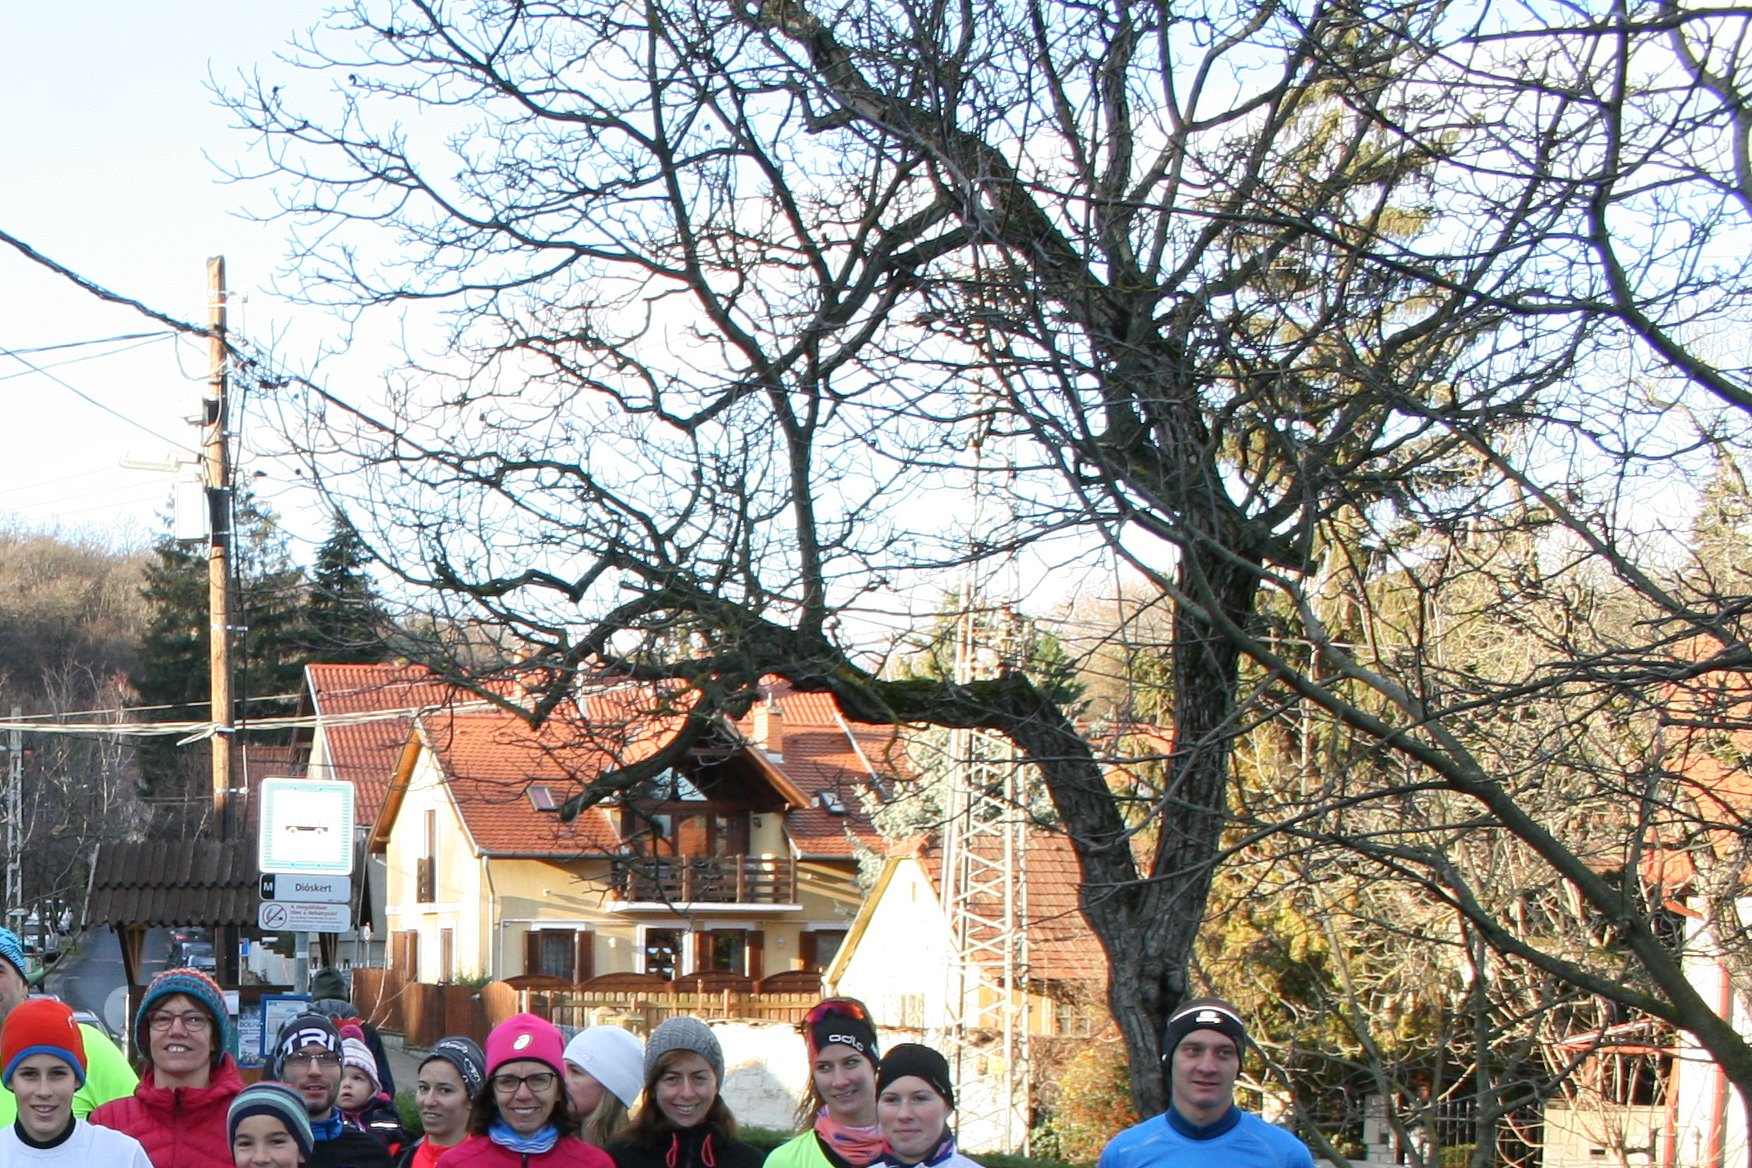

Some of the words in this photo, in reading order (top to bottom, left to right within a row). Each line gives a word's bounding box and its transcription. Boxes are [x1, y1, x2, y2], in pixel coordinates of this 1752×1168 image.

[263, 882, 273, 891] M
[295, 883, 332, 893] Dióskert
[282, 1028, 336, 1056] TRI
